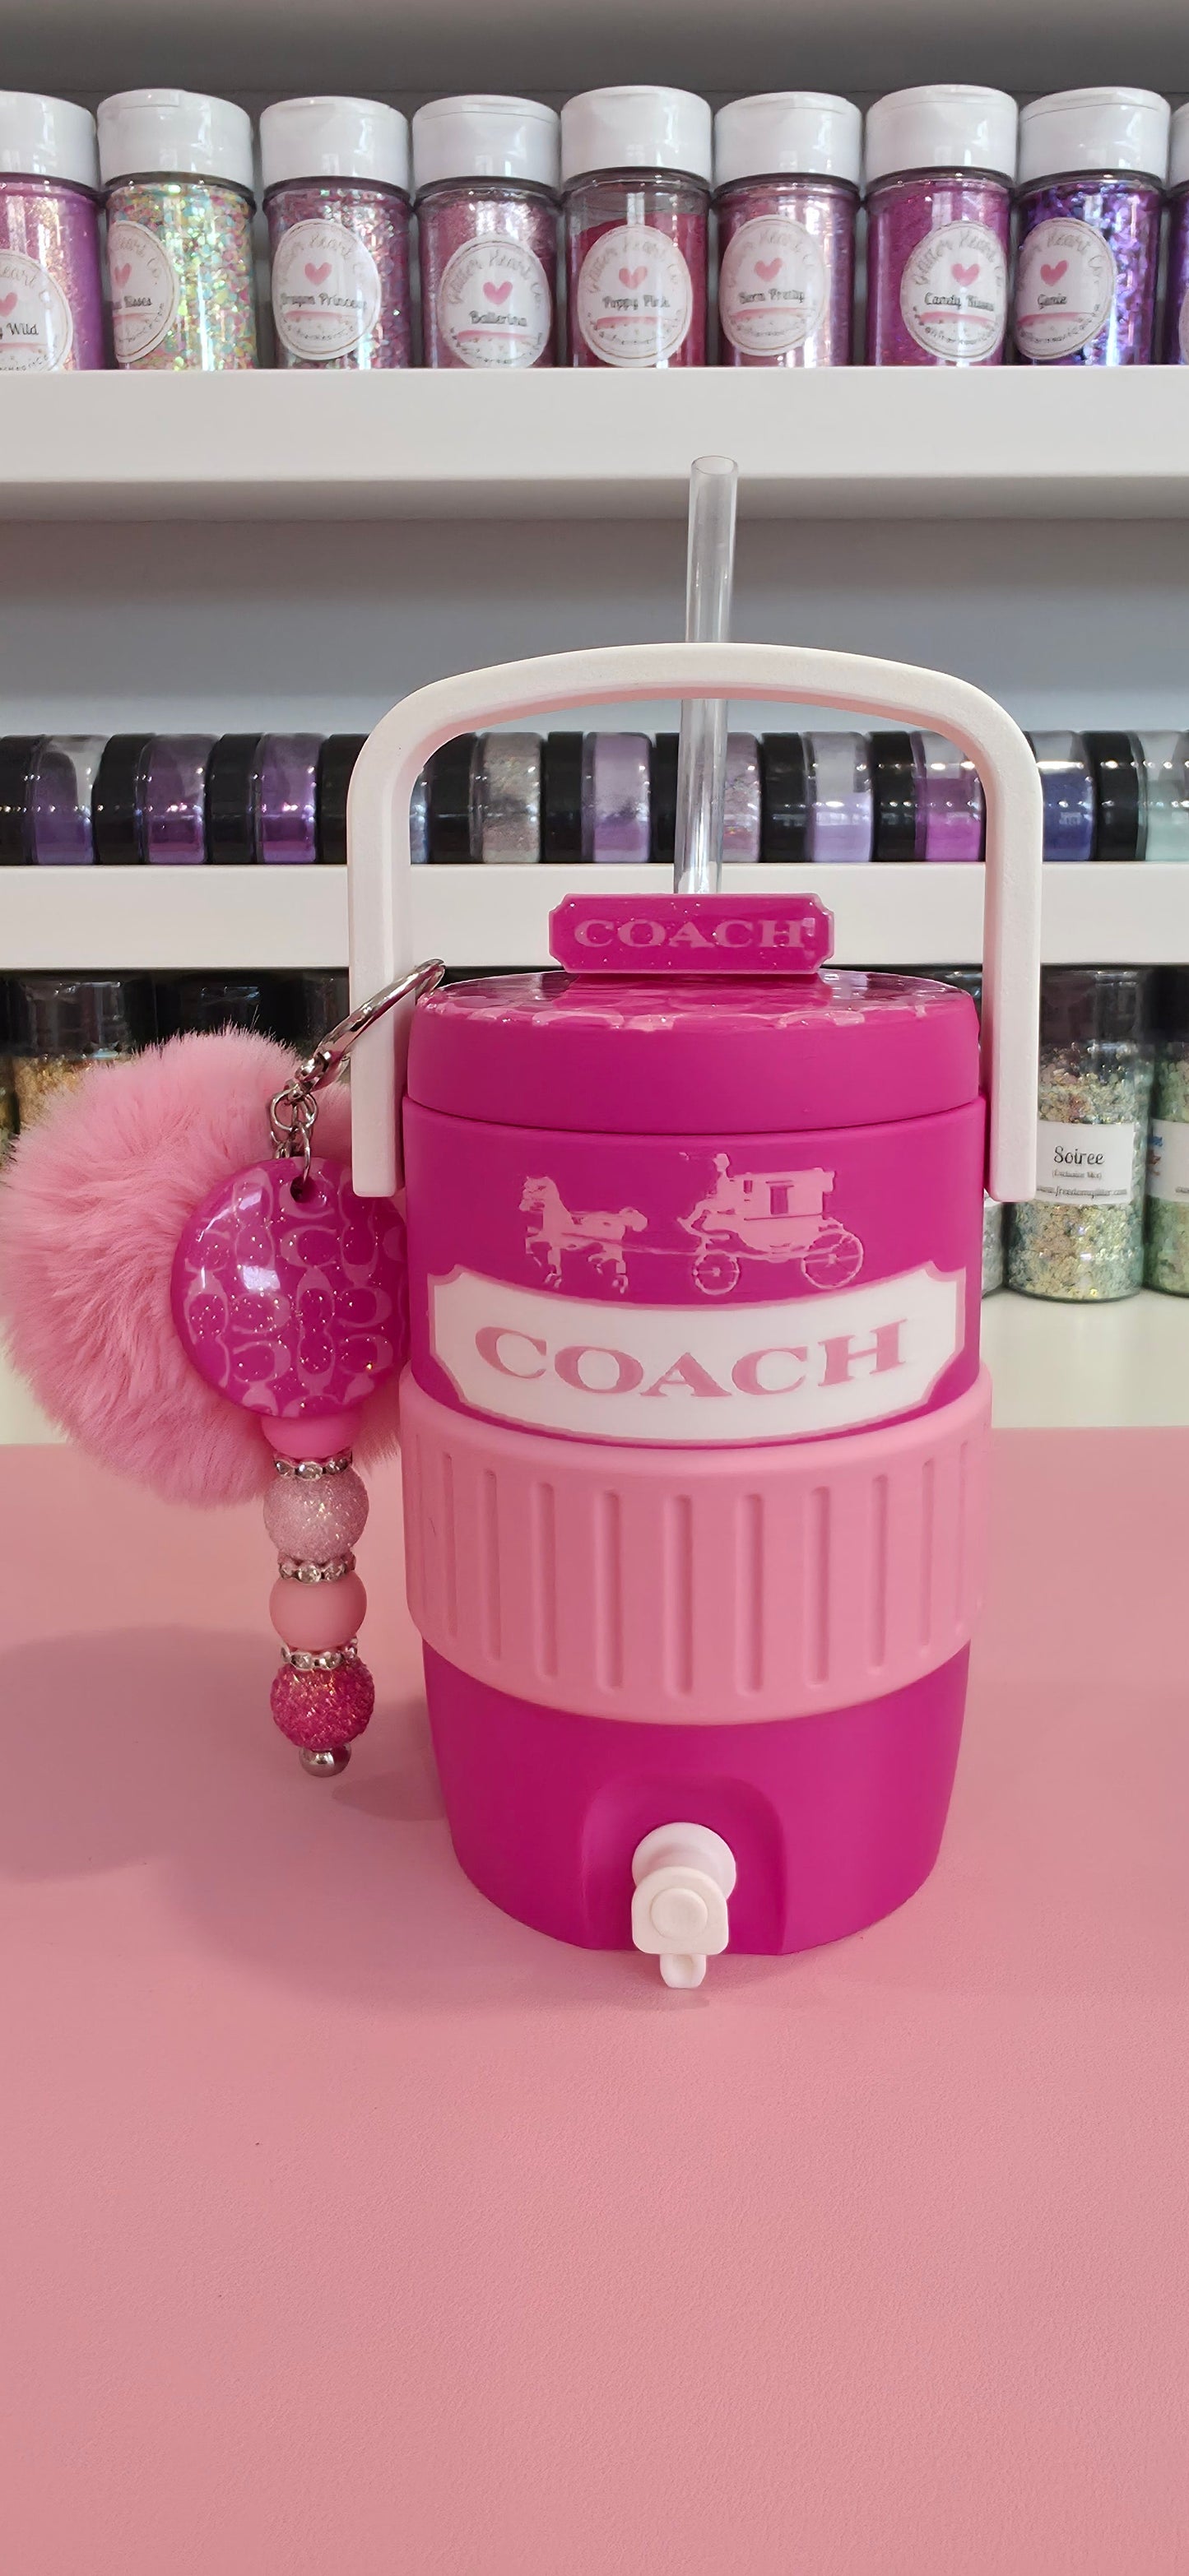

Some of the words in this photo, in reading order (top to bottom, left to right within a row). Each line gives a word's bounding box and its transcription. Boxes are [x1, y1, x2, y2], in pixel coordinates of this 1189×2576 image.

[924, 292, 961, 310] Candy
[469, 310, 527, 327] Ballerina
[7, 322, 39, 336] Wild
[575, 918, 806, 948] COACH
[1054, 1145, 1105, 1165] Soiree
[475, 1319, 908, 1398] COACH
